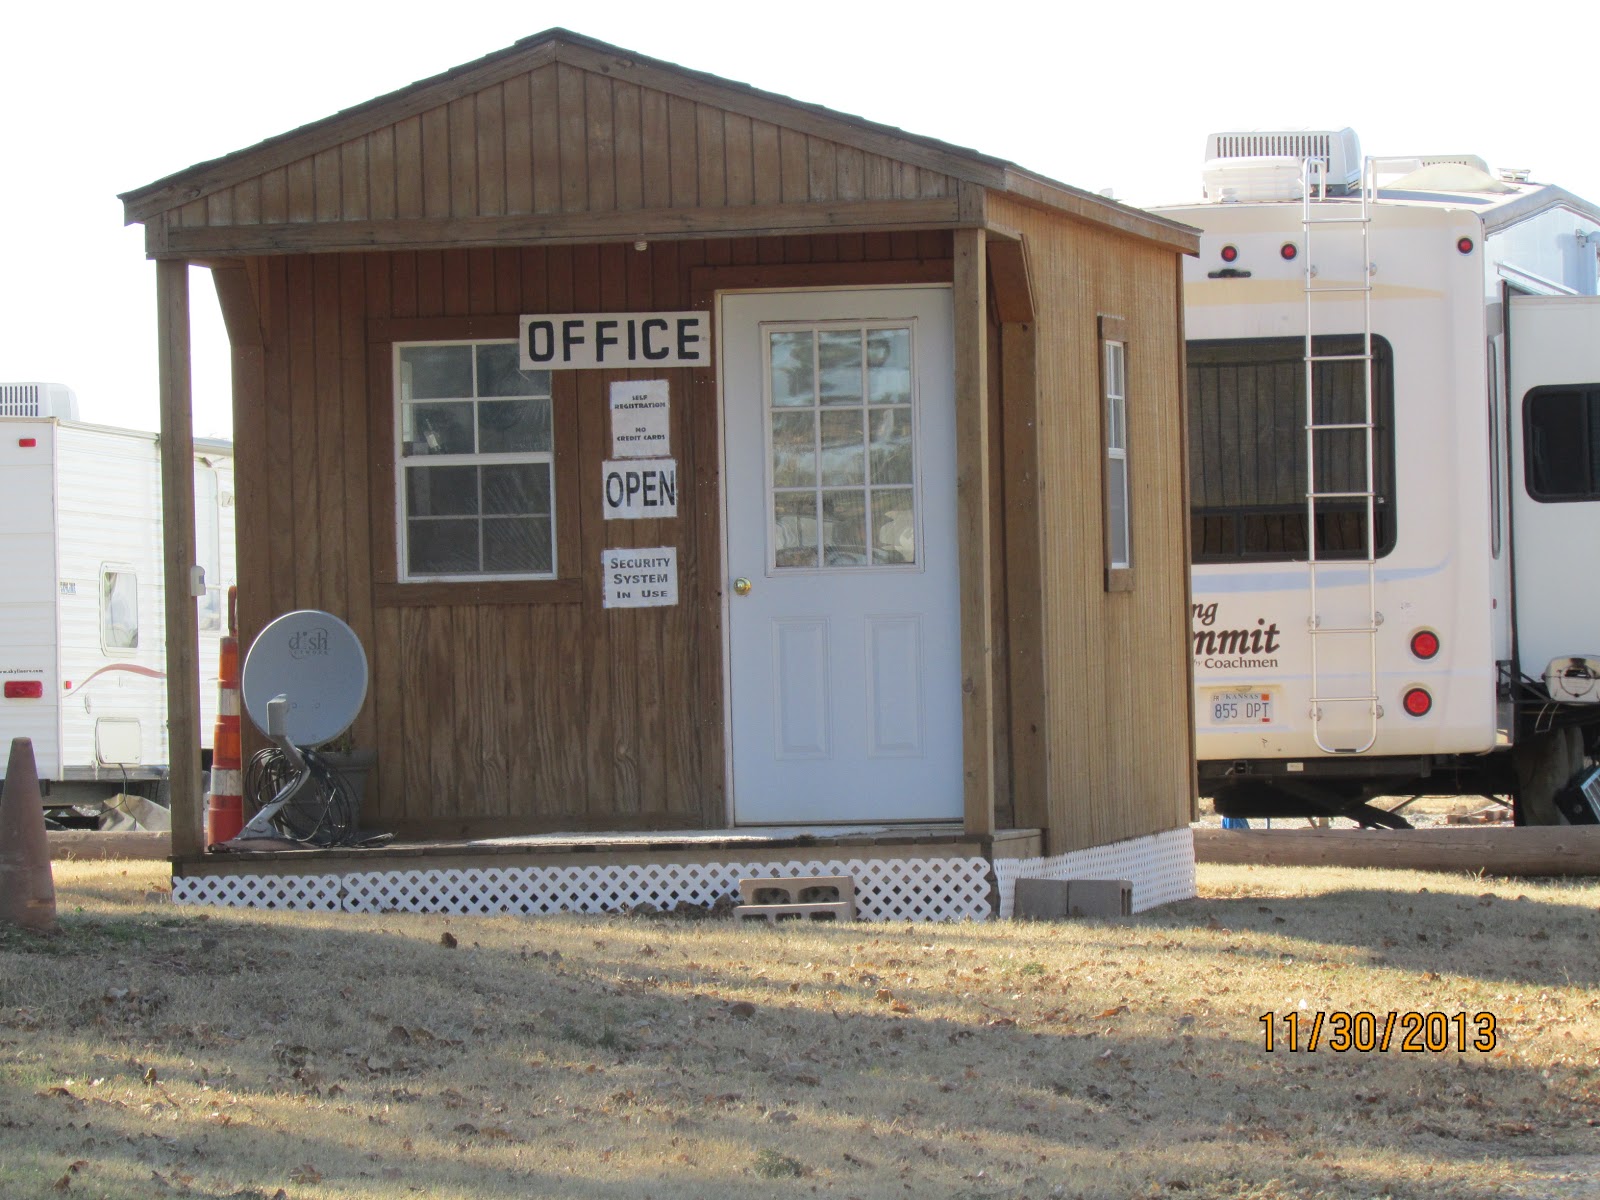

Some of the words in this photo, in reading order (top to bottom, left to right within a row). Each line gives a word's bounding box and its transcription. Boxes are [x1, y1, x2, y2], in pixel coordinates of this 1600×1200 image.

[528, 318, 700, 362] OFFICE
[605, 470, 675, 508] OPEN
[610, 557, 671, 569] SECURITY
[613, 573, 668, 585] SYSTEM
[641, 590, 668, 598] USE
[288, 631, 328, 651] dish
[1204, 656, 1279, 669] Coachmen
[1225, 692, 1260, 700] KANSAS
[1214, 703, 1238, 719] 855
[1245, 702, 1269, 718] DPT
